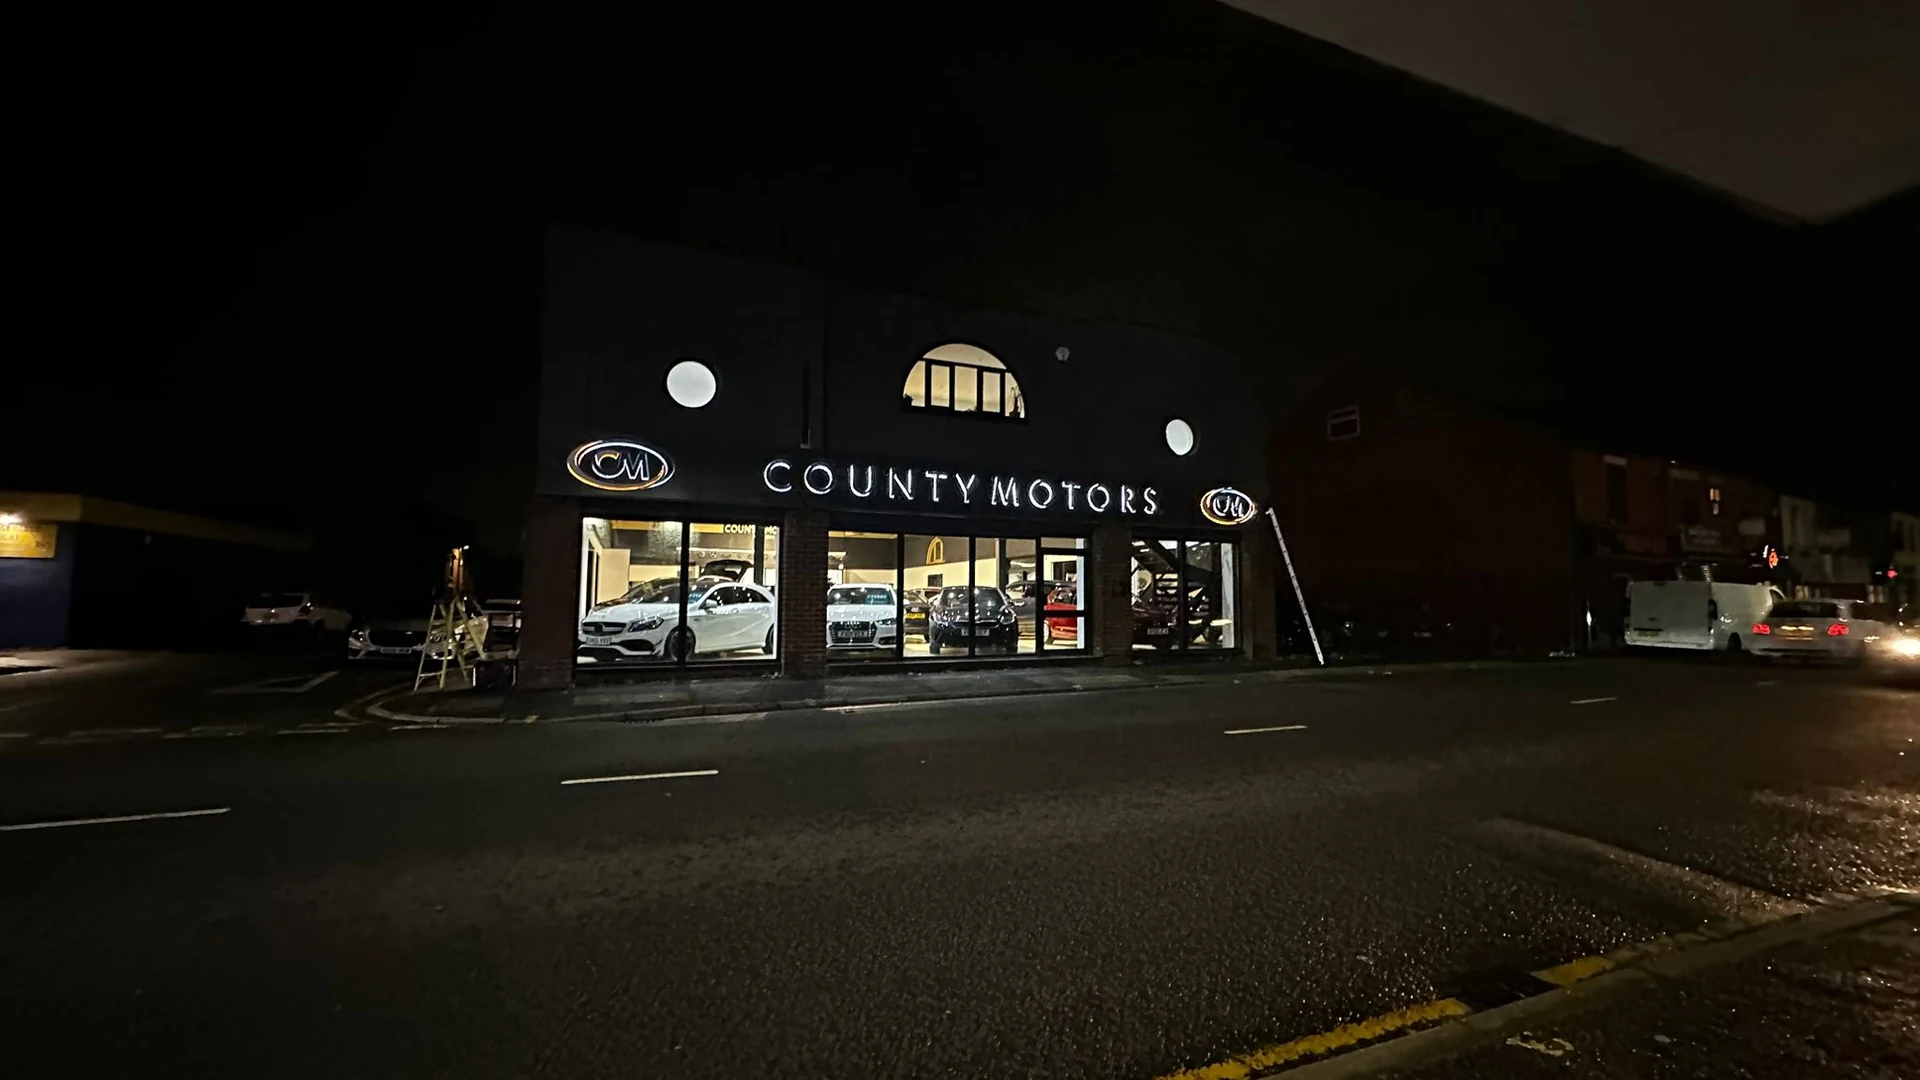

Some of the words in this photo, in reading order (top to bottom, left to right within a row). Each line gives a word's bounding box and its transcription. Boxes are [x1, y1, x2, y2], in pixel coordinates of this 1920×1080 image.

[591, 450, 650, 481] CM
[763, 458, 978, 504] COUNTY
[991, 475, 1159, 515] MOTORS
